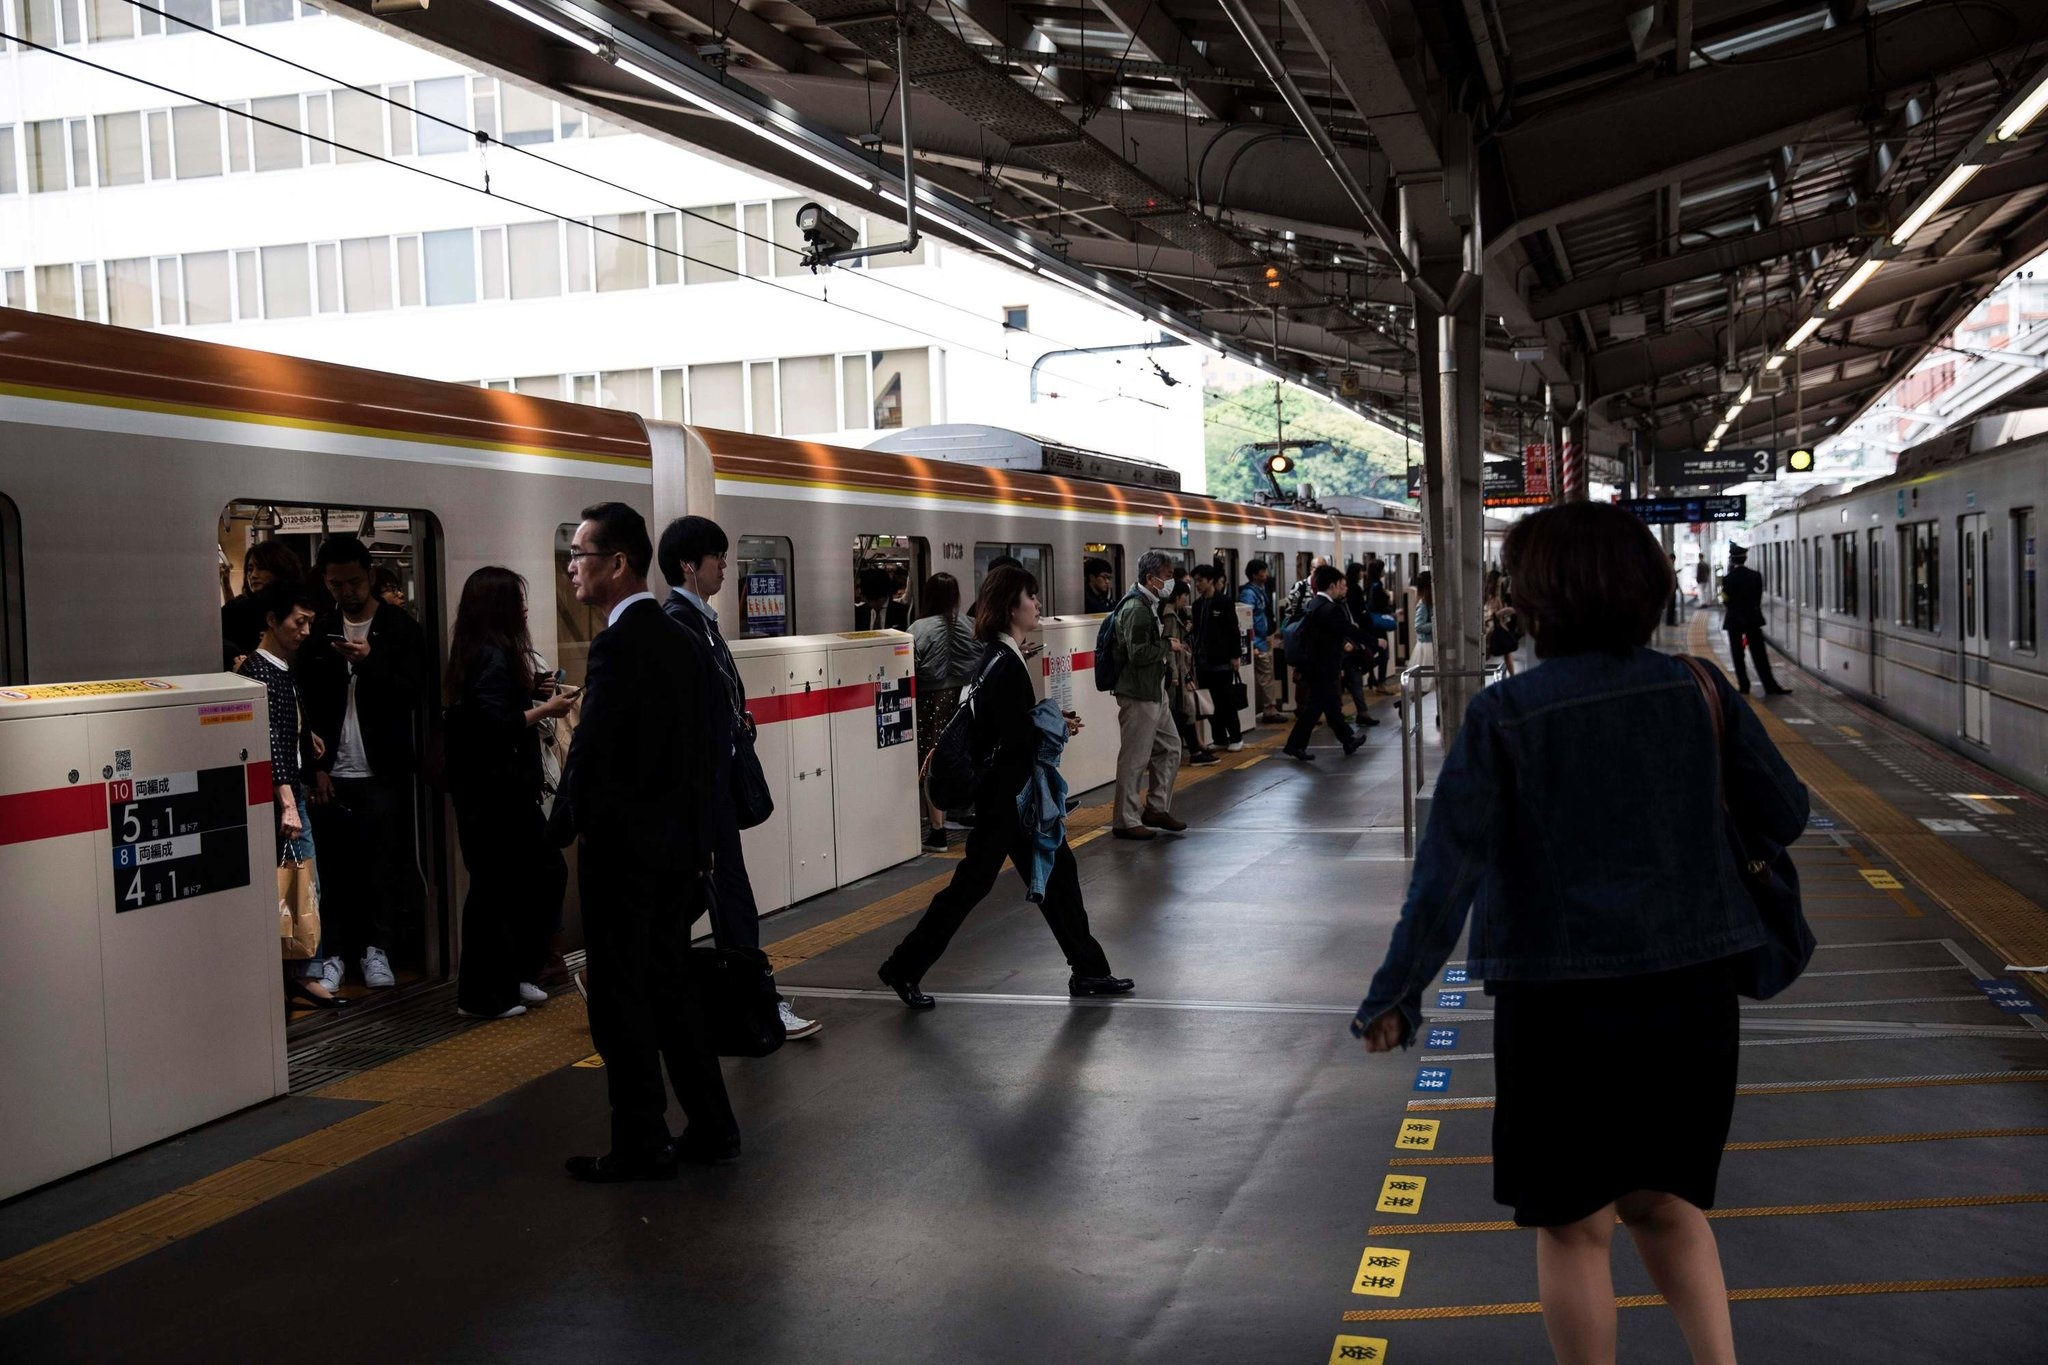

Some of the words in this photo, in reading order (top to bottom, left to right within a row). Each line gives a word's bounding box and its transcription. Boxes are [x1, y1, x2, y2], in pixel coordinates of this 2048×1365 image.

[1753, 450, 1770, 474] 3
[750, 577, 776, 594] 優先席
[878, 694, 884, 714] 4
[889, 697, 894, 711] 4
[880, 727, 886, 747] 3
[890, 730, 895, 744] 4
[113, 783, 129, 800] 10
[135, 778, 170, 797] 両編成
[122, 803, 141, 843] 5
[165, 807, 174, 835] 1
[120, 849, 129, 865] 8
[139, 841, 173, 861] 両編成
[125, 867, 146, 906] 4
[168, 870, 177, 898] 1
[1402, 1123, 1433, 1145] 後発
[1384, 1181, 1418, 1207] 後発
[1361, 1256, 1401, 1289] 後発
